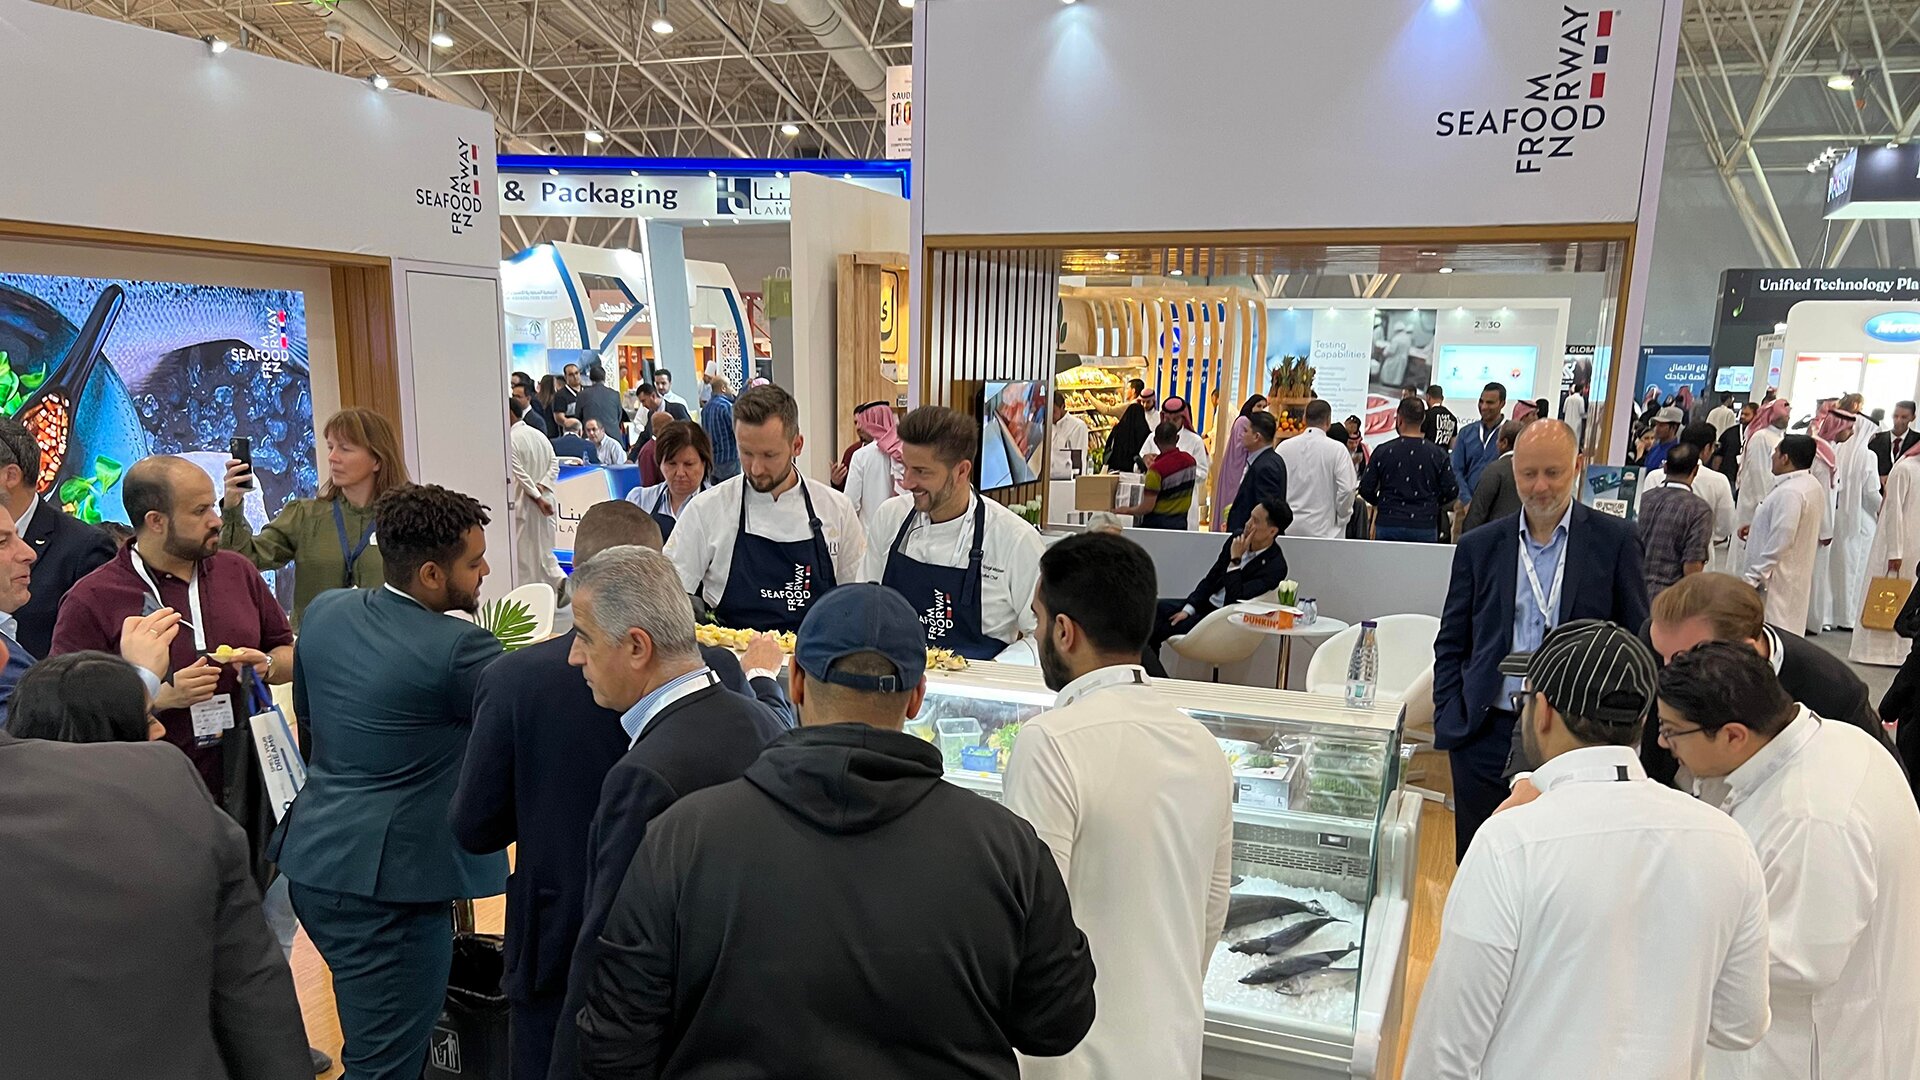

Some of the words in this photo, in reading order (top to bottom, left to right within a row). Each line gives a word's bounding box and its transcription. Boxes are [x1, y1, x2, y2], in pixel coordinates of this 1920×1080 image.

[892, 91, 911, 100] SAUD
[1547, 5, 1590, 158] NORWAY
[1436, 104, 1606, 137] SEAFOOD
[1515, 73, 1552, 173] FROM
[458, 137, 473, 227] NORWAY
[503, 180, 525, 202] &
[542, 181, 678, 210] Packaging
[416, 188, 482, 213] SEAFOOD
[449, 176, 462, 234] FROM
[1759, 278, 1811, 291] Unified
[1813, 278, 1895, 293] Technology
[1896, 277, 1920, 290] Pla
[231, 347, 290, 361] SEAFOOD
[1314, 350, 1367, 359] Capabilities
[1315, 341, 1347, 350] Testing
[1569, 346, 1595, 354] GLOBA
[760, 589, 811, 599] SEAFOOD
[785, 582, 797, 611] FROM
[794, 563, 805, 607] NORWAY
[919, 614, 954, 629] AFOOD
[926, 607, 937, 640] FROM
[934, 588, 947, 637] NORWAY
[1243, 613, 1279, 629] DUNKIN'
[267, 734, 283, 772] DREAMS
